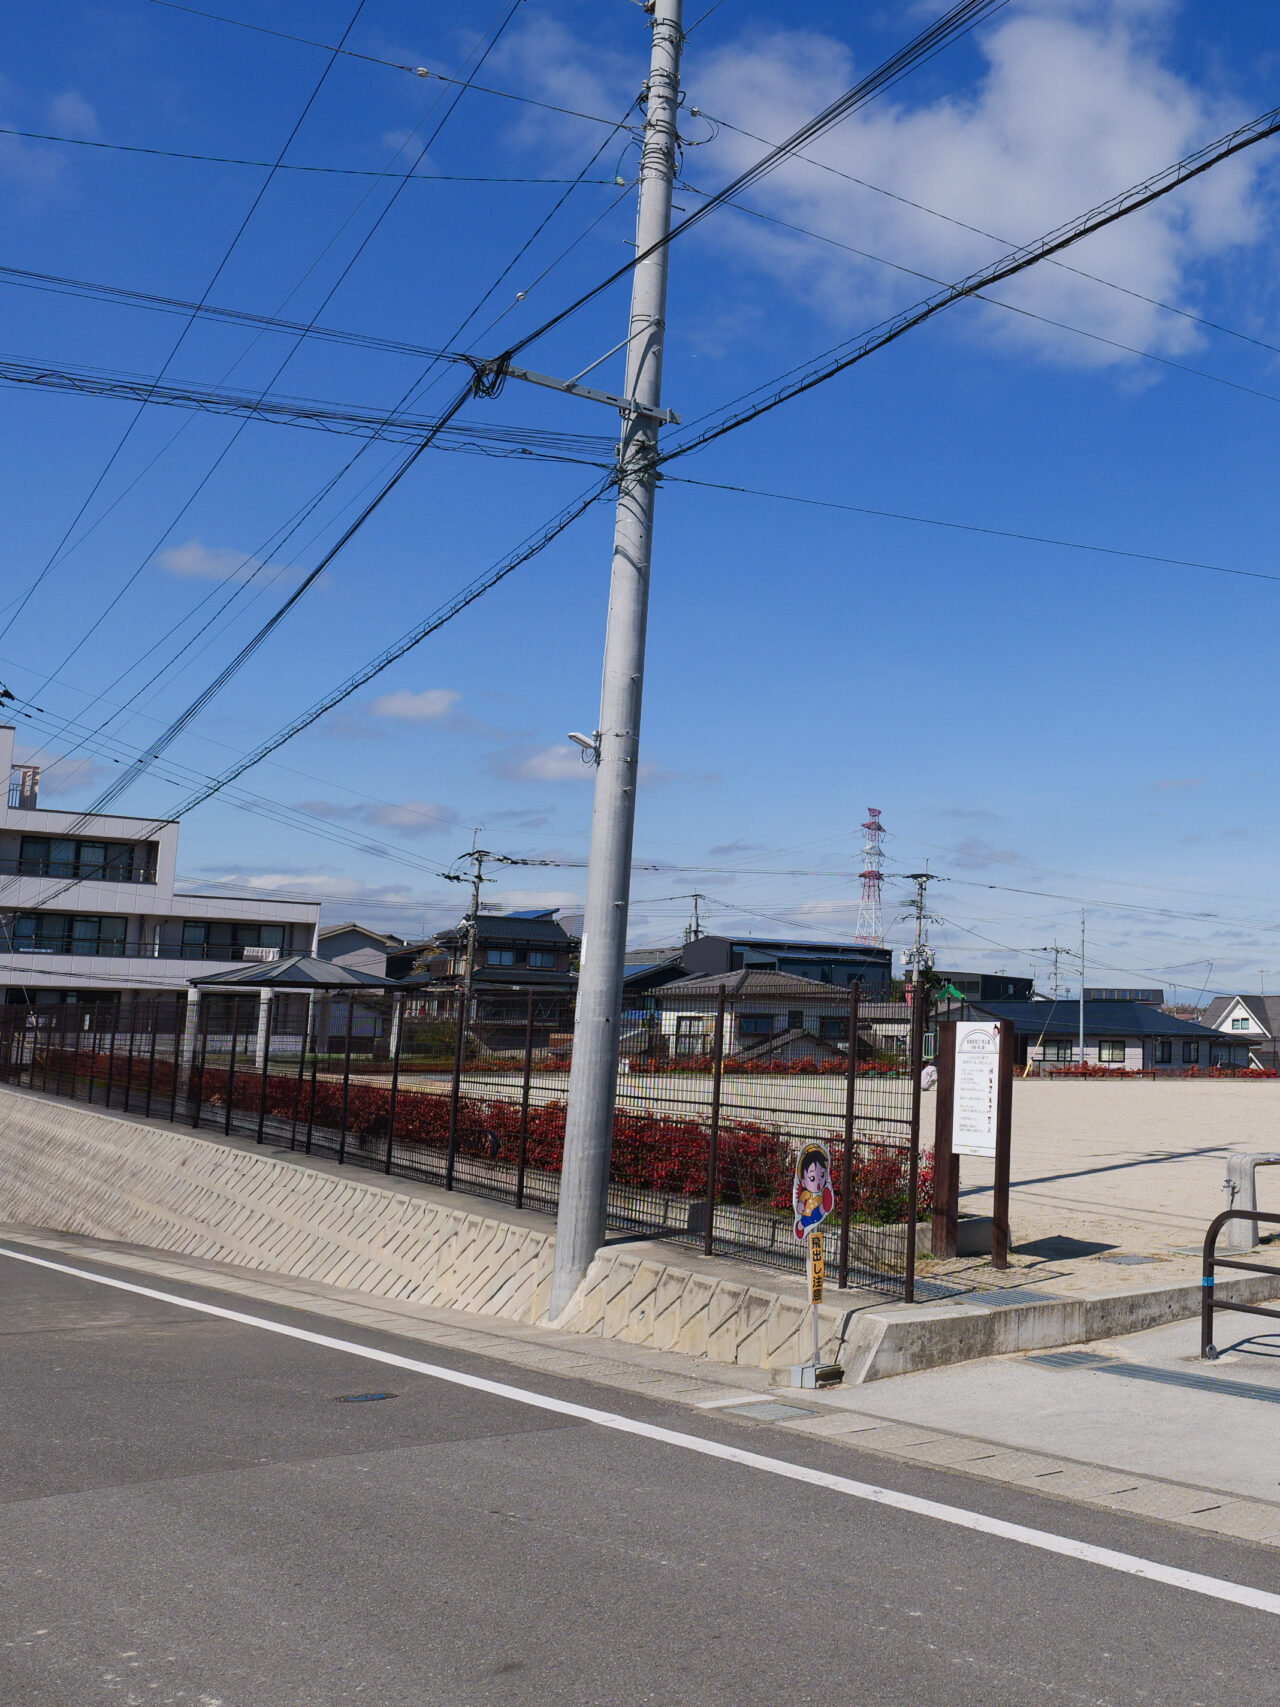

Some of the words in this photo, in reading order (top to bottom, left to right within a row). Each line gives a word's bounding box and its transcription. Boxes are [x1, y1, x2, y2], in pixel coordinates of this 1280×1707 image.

[811, 1237, 823, 1302] 飛出し注意
